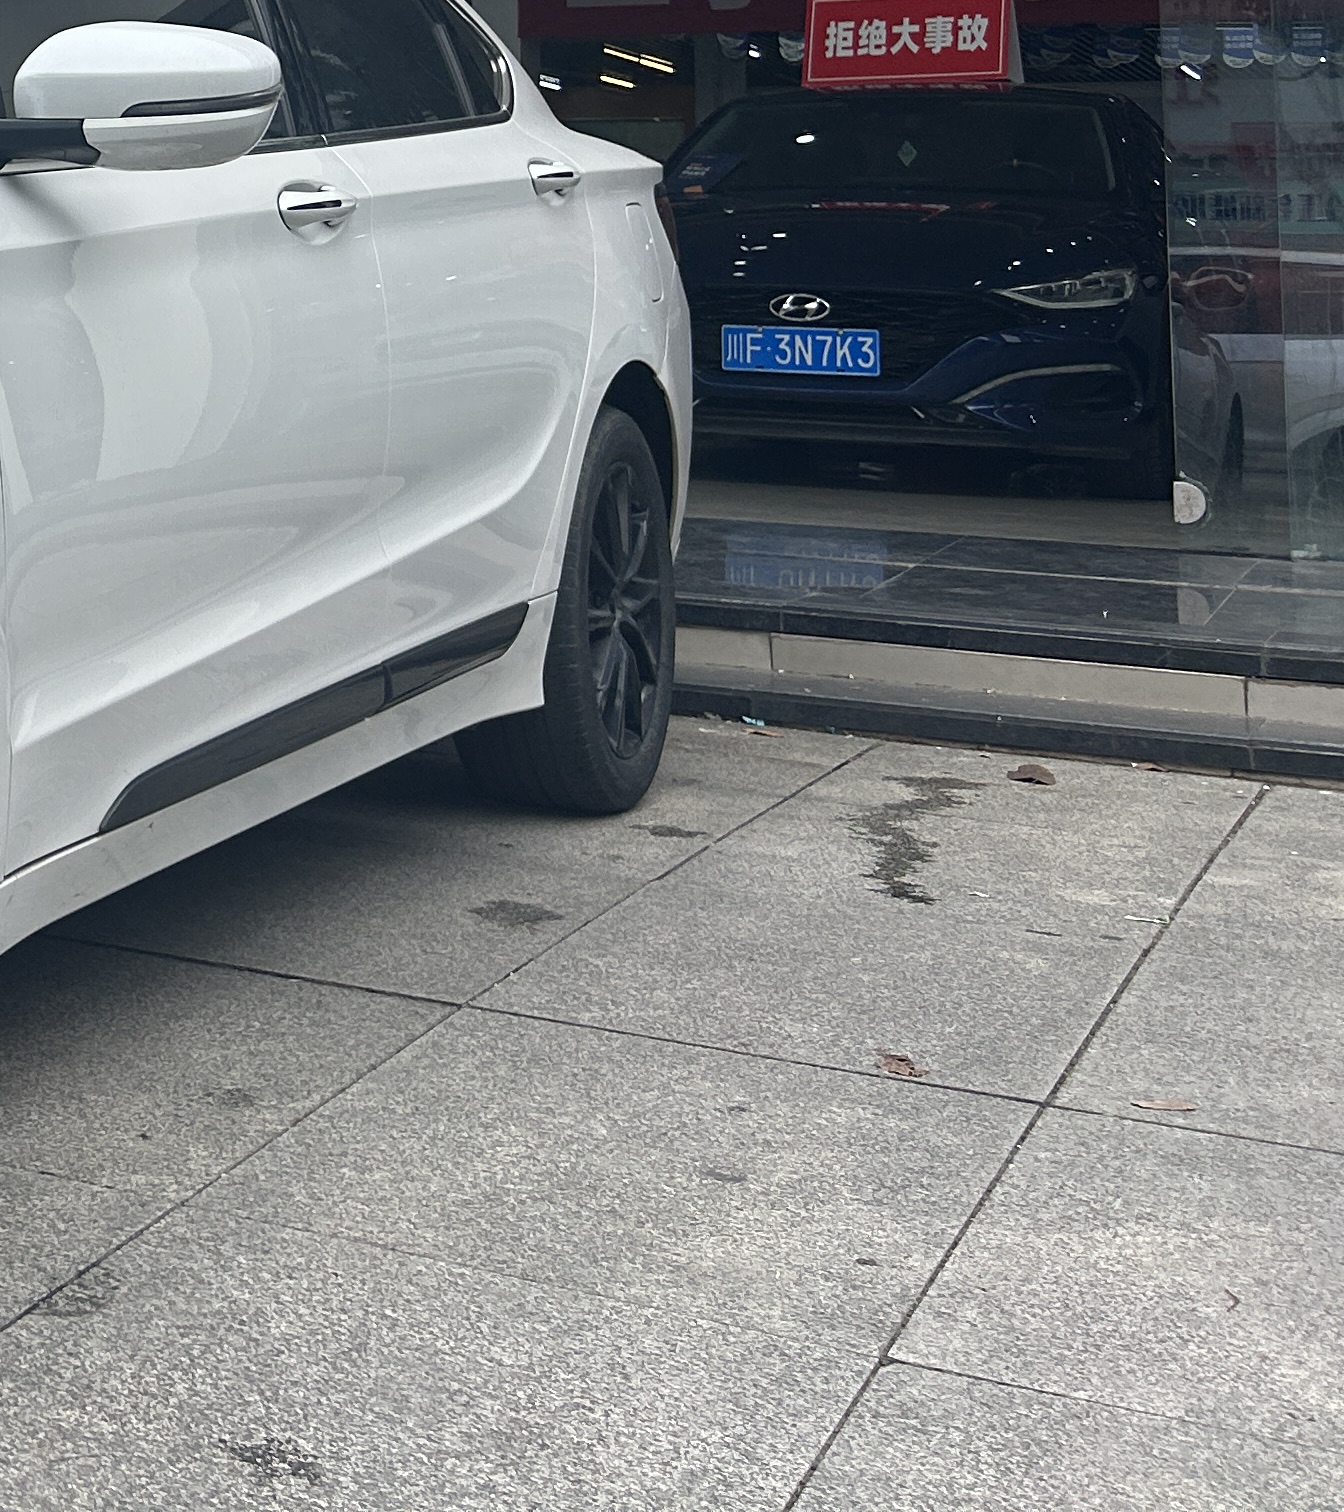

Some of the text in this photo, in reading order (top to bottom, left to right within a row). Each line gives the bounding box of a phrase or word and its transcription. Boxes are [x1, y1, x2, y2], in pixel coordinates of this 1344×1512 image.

[824, 13, 989, 58] 拒绝大事故
